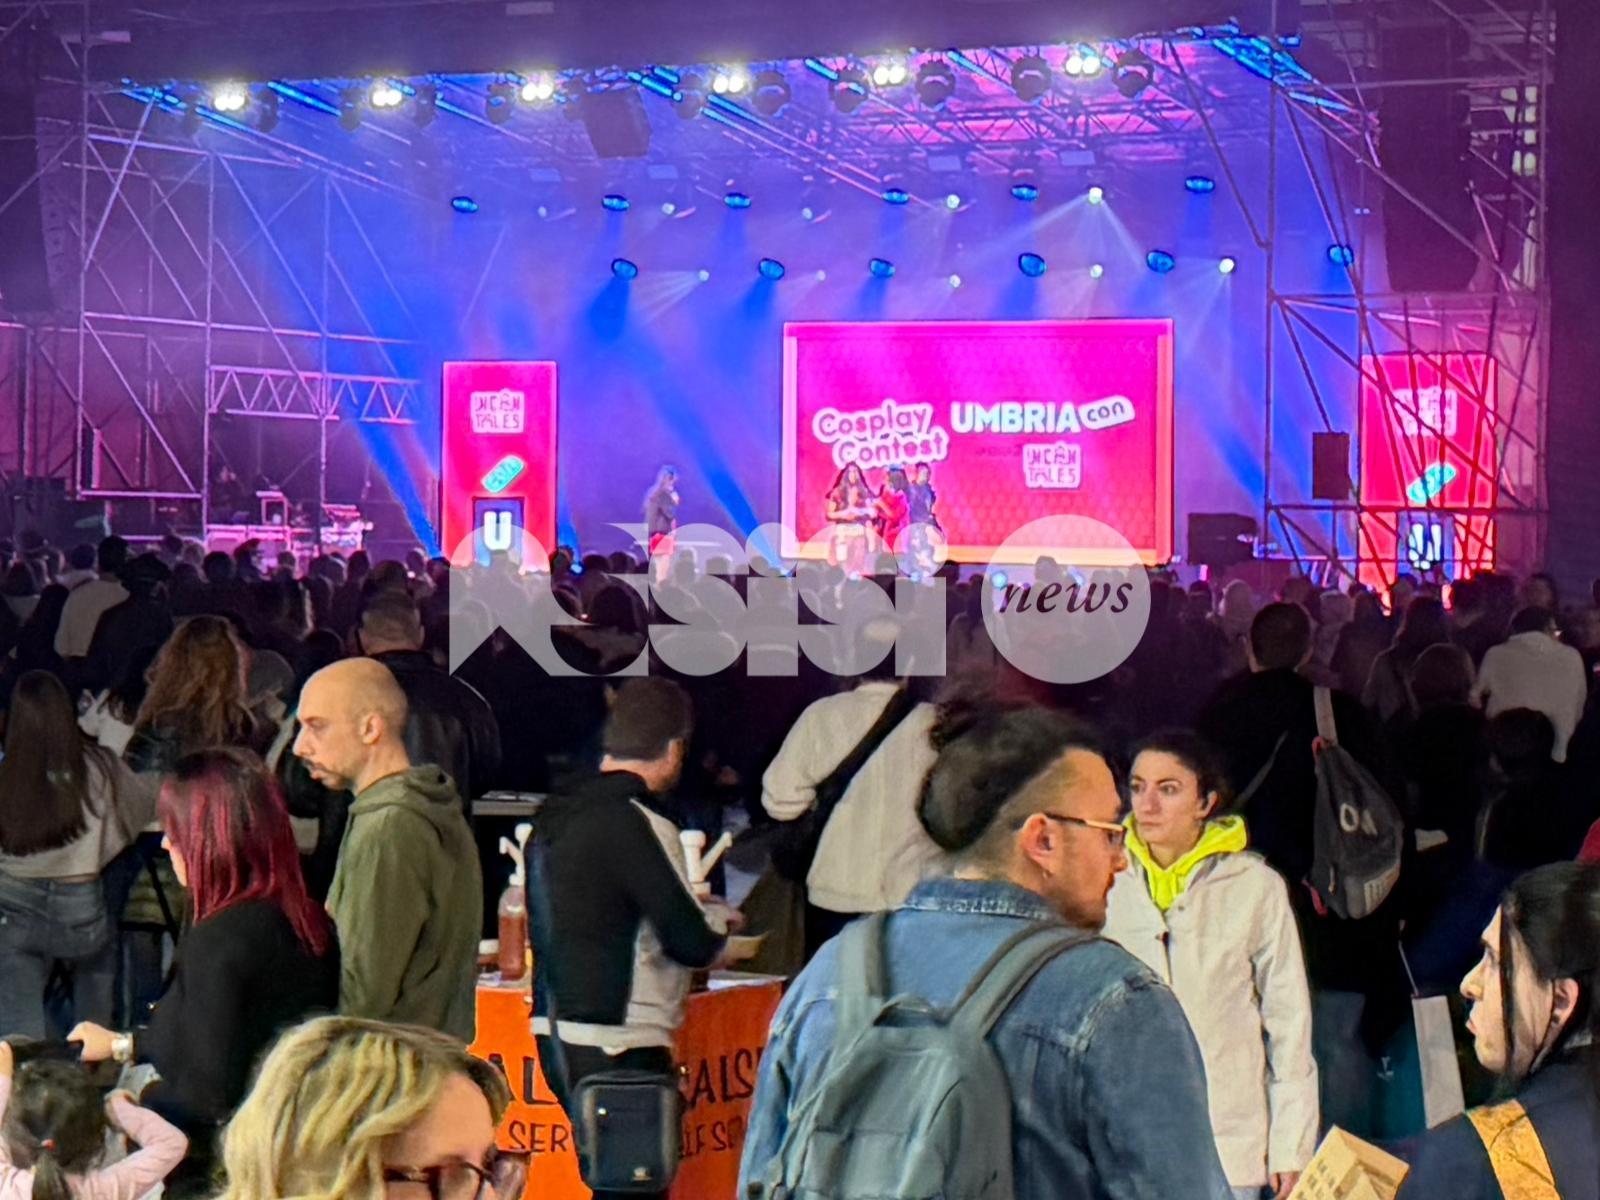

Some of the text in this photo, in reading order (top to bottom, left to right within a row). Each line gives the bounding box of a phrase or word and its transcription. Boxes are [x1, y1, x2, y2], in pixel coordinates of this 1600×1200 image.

[818, 404, 928, 439] Cosplay
[951, 401, 1125, 433] UMBRIA con
[838, 430, 944, 463] Contest
[484, 511, 512, 550] U
